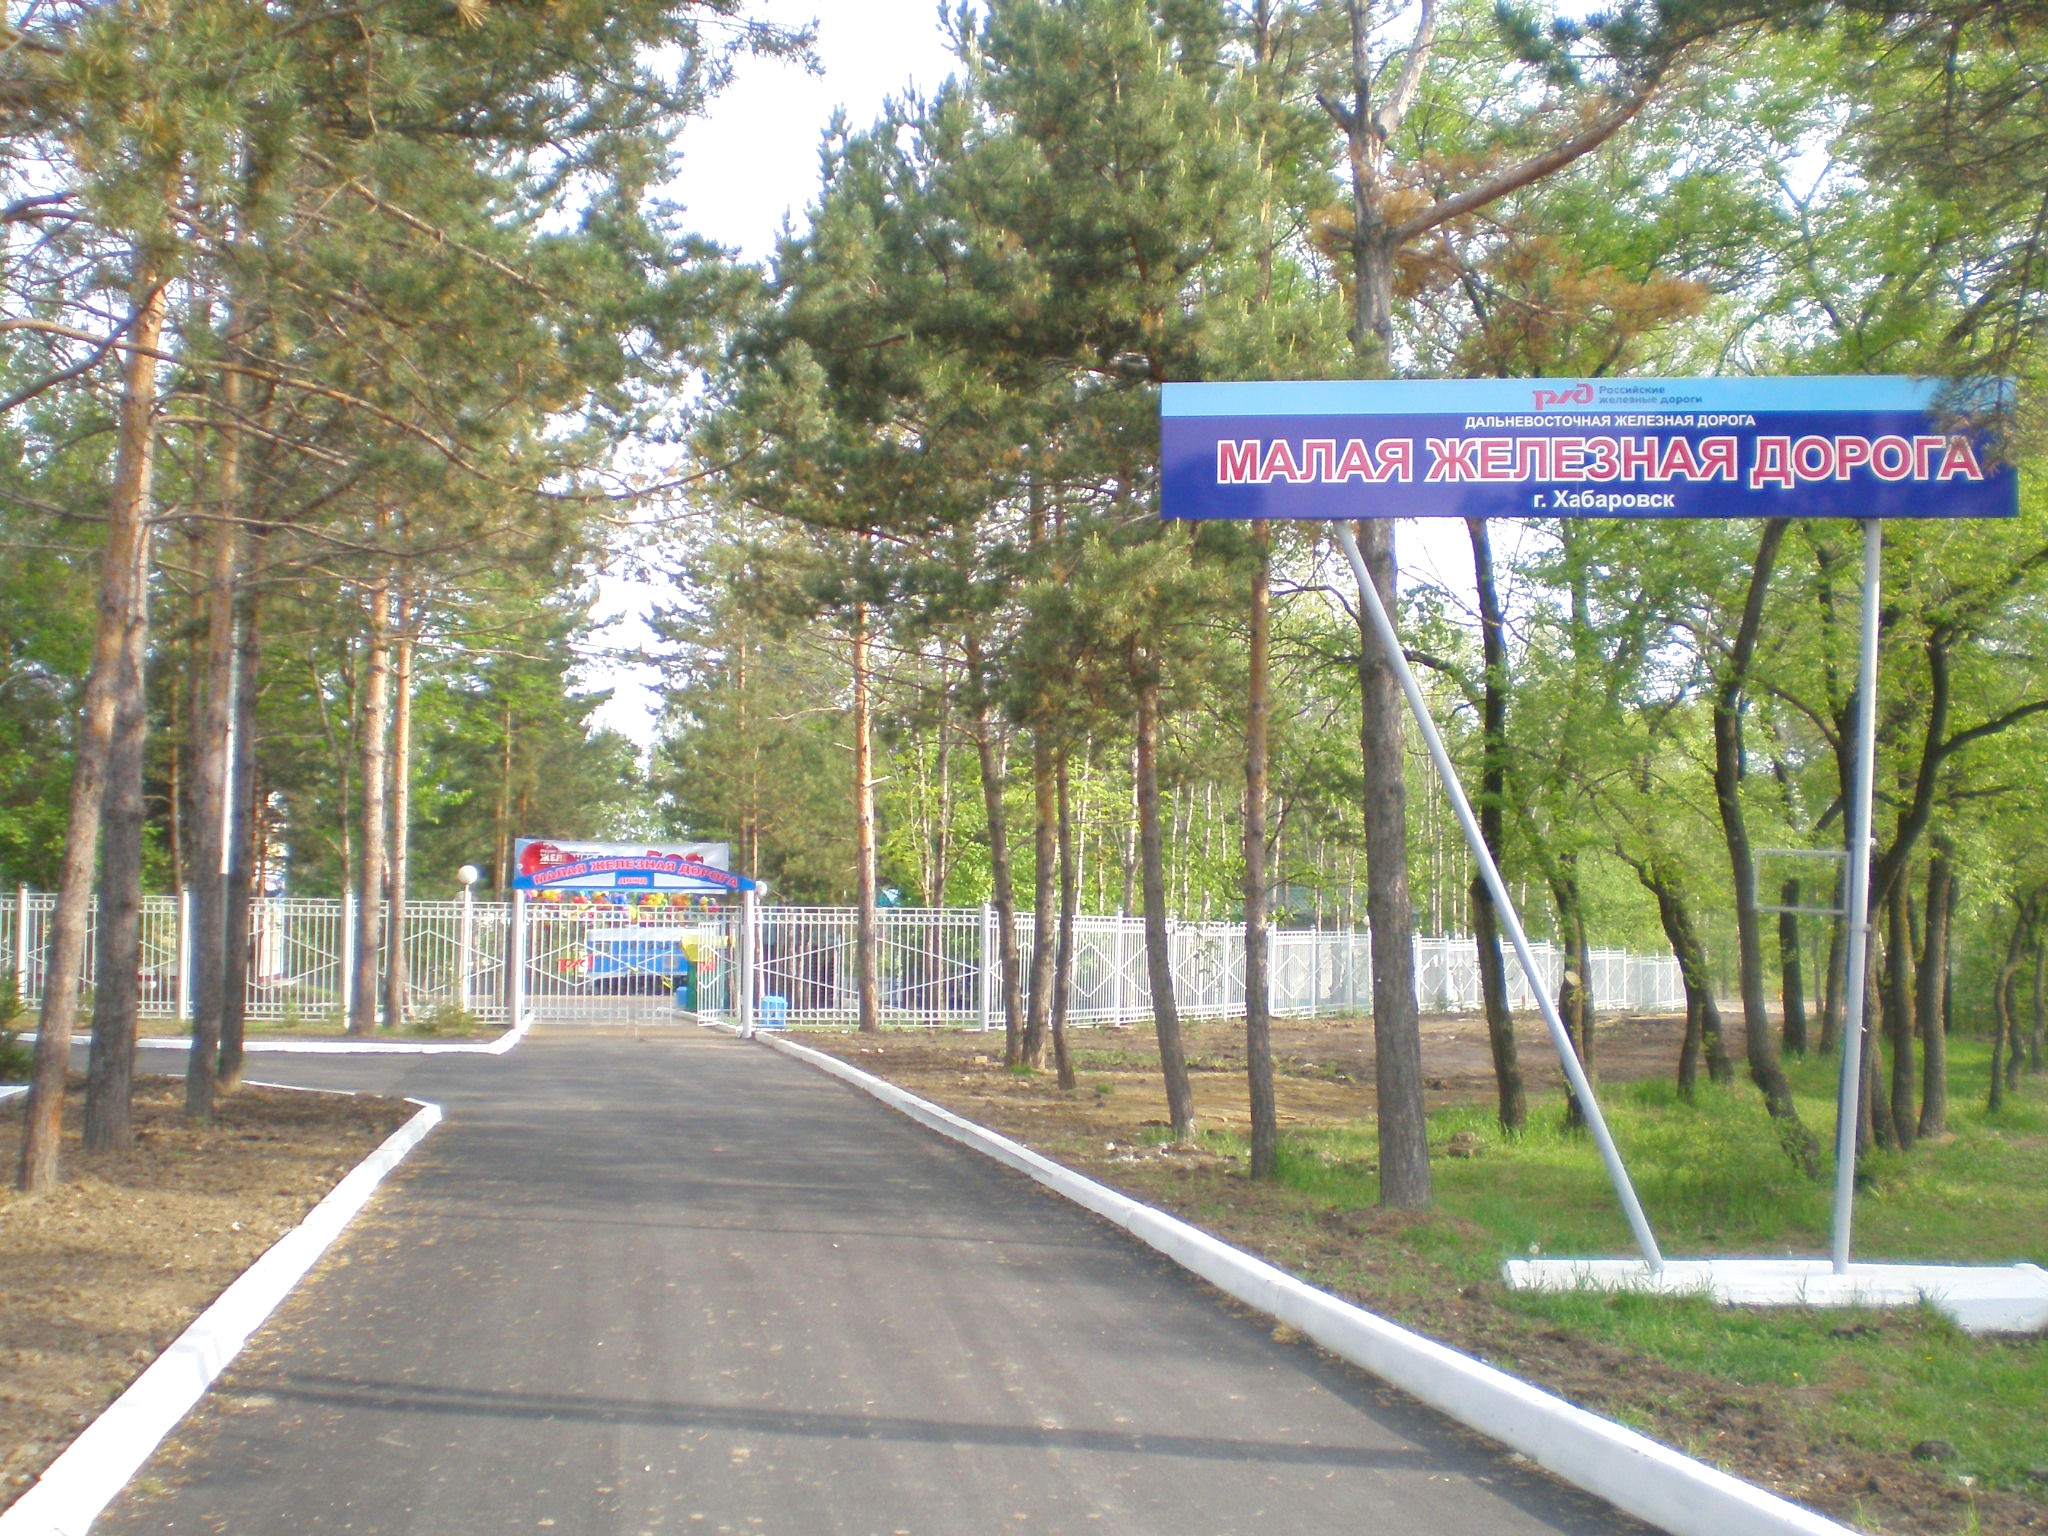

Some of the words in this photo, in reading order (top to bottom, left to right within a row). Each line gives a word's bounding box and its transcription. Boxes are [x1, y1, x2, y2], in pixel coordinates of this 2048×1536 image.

[1599, 385, 1665, 395] Российские
[1599, 395, 1657, 404] железные
[1660, 395, 1702, 405] дороги
[1465, 415, 1611, 430] ДАЛЬНЕВОСТОЧНАЯ
[1614, 415, 1694, 427] ЖЕЛЕЗНАЯ
[1697, 414, 1756, 428] ДОРОГА
[1217, 438, 1413, 483] МАЛАЯ
[1424, 436, 1738, 482] ЖЕЛЕЗНАЯ
[1750, 436, 1984, 489] ДОРОГА
[1533, 494, 1546, 508] г.
[1554, 490, 1675, 511] Хабаровск
[533, 863, 587, 885] МАЛАЯ
[590, 857, 675, 872] ЖЕЛЕЗНАЯ
[678, 863, 738, 887] ДОРОГА
